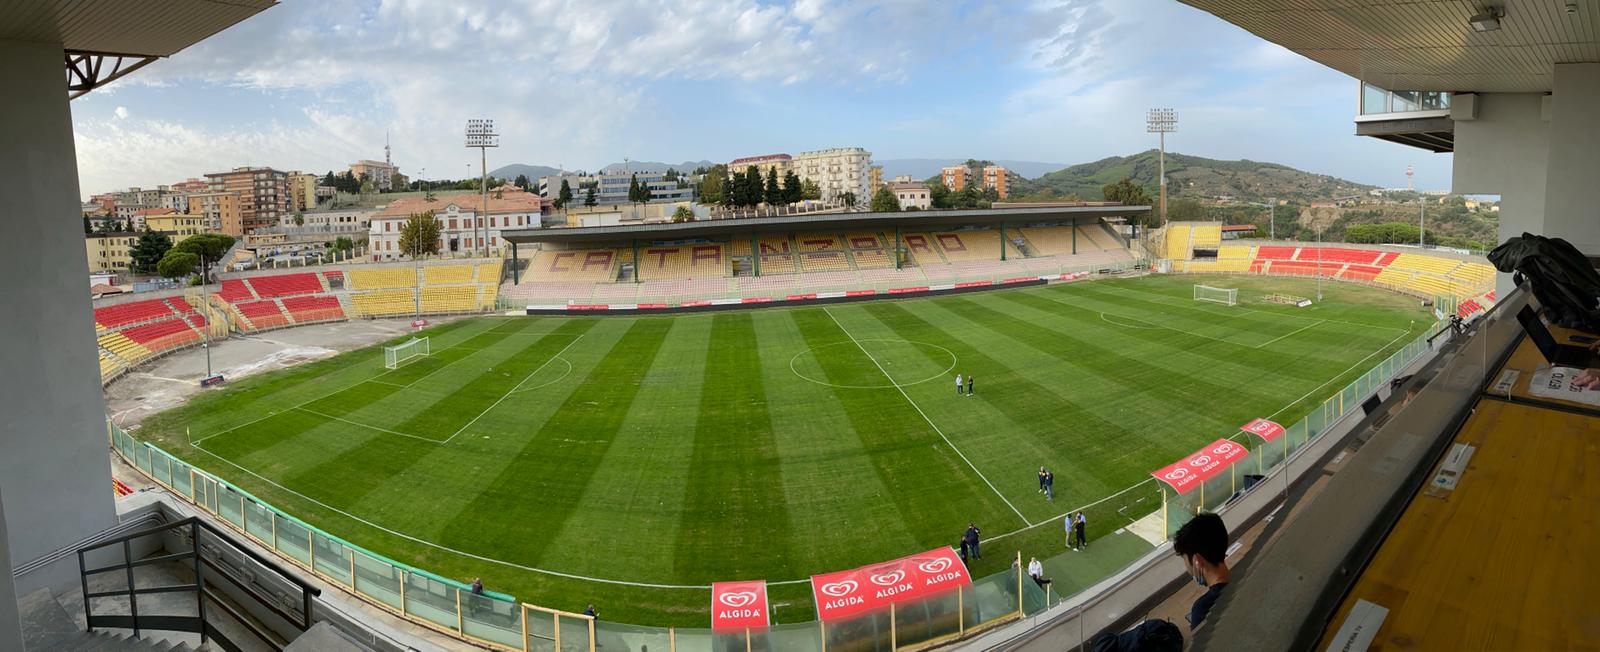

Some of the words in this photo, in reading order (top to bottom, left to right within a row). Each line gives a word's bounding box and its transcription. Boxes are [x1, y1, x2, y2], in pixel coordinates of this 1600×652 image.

[550, 234, 968, 273] CATANZARO
[1177, 473, 1198, 486] ALGIDA
[825, 595, 864, 610] ALGIDA
[876, 583, 913, 599] ALGIDA
[926, 570, 961, 586] ALGIDA
[719, 609, 761, 619] ALGIDA
